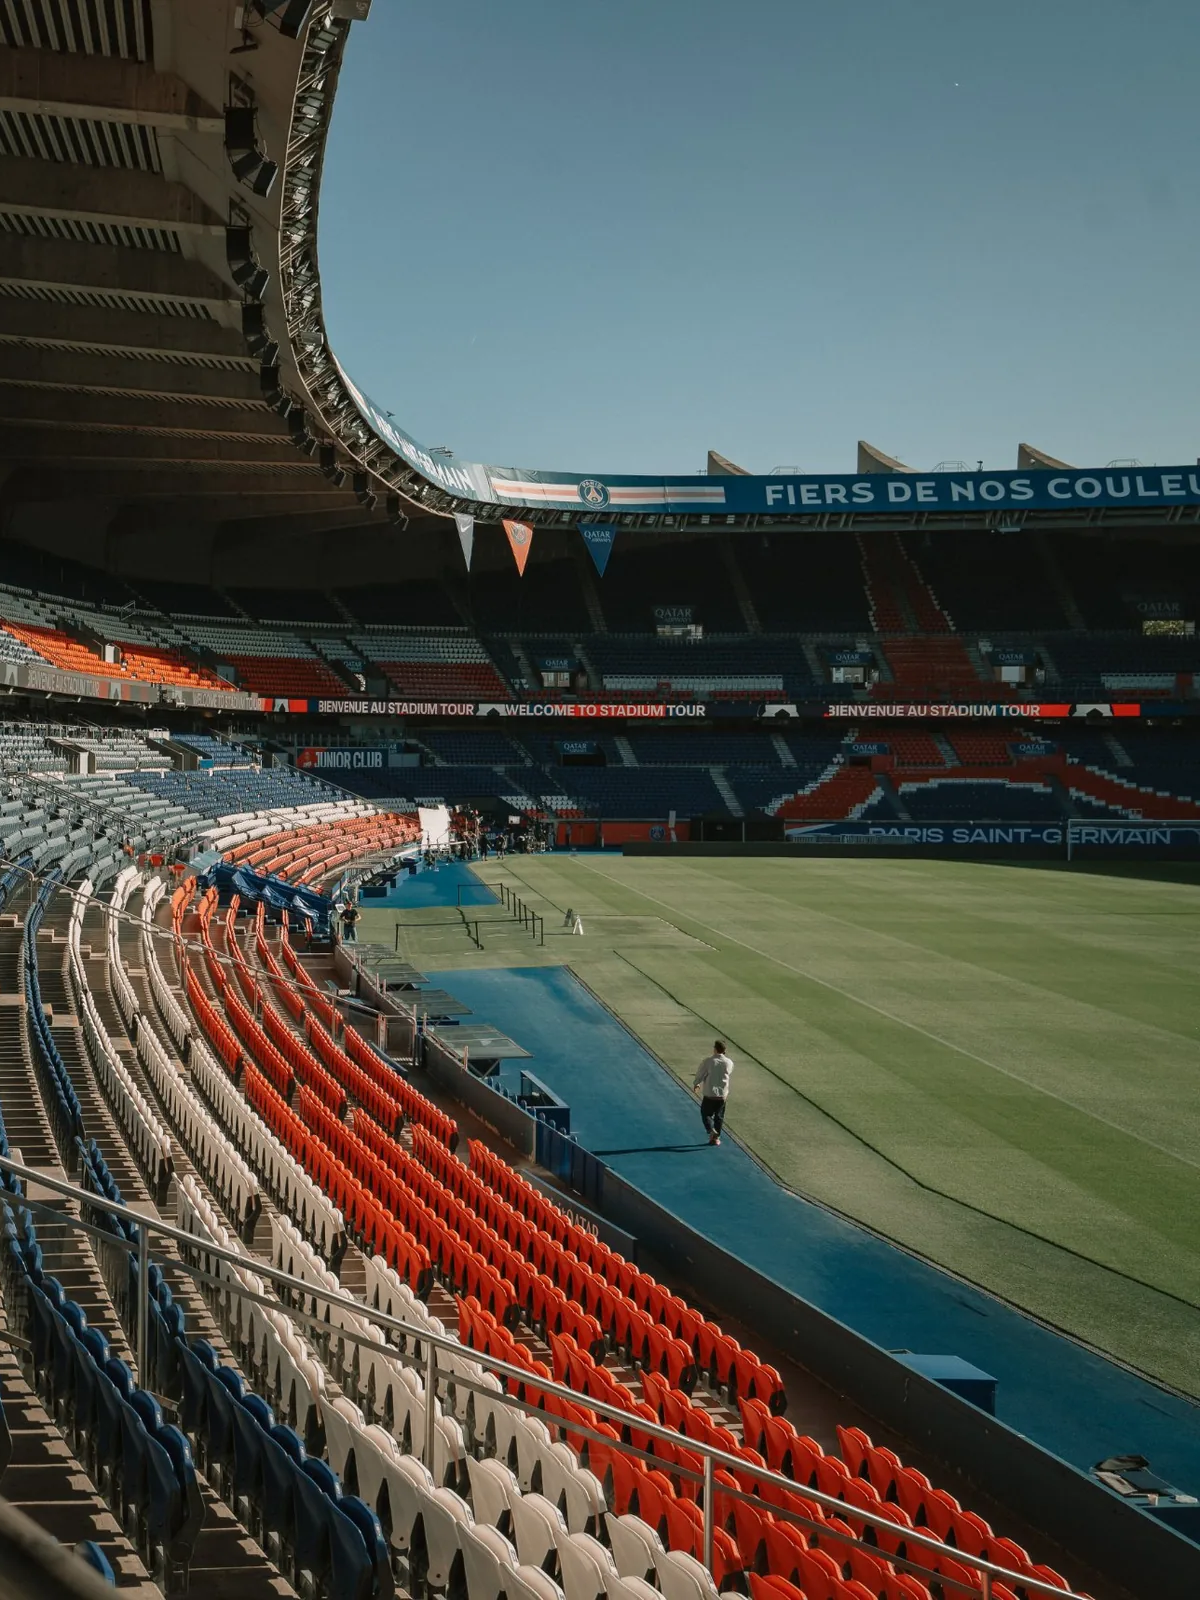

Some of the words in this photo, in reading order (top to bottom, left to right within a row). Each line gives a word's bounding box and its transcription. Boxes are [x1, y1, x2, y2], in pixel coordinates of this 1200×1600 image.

[765, 482, 875, 505] FIERS
[887, 481, 938, 502] DE
[950, 478, 1034, 502] NOS
[583, 530, 611, 540] QATAR
[655, 608, 692, 618] QATAR
[835, 653, 860, 661] QATAR
[998, 653, 1024, 661] QATAR
[318, 700, 368, 713] BIENVENUE
[370, 701, 386, 714] AU
[388, 702, 437, 715] STADIUM
[441, 703, 474, 716] TOUR
[505, 704, 574, 717] WELCOME
[578, 704, 597, 717] TO
[599, 704, 663, 717] STADIUM
[666, 704, 706, 717] TOUR
[828, 704, 904, 717] BIENVENUE
[907, 704, 927, 717] AU
[930, 704, 997, 717] STADIUM
[999, 704, 1040, 717] TOUR
[563, 742, 587, 750] QATAR
[852, 744, 878, 752] QATAR
[1019, 744, 1045, 752] QATAR
[314, 752, 351, 769] JUNIOR
[352, 752, 382, 768] CLUB
[868, 828, 944, 844] PARIS
[951, 827, 1172, 845] SAINT-GERMAIN
